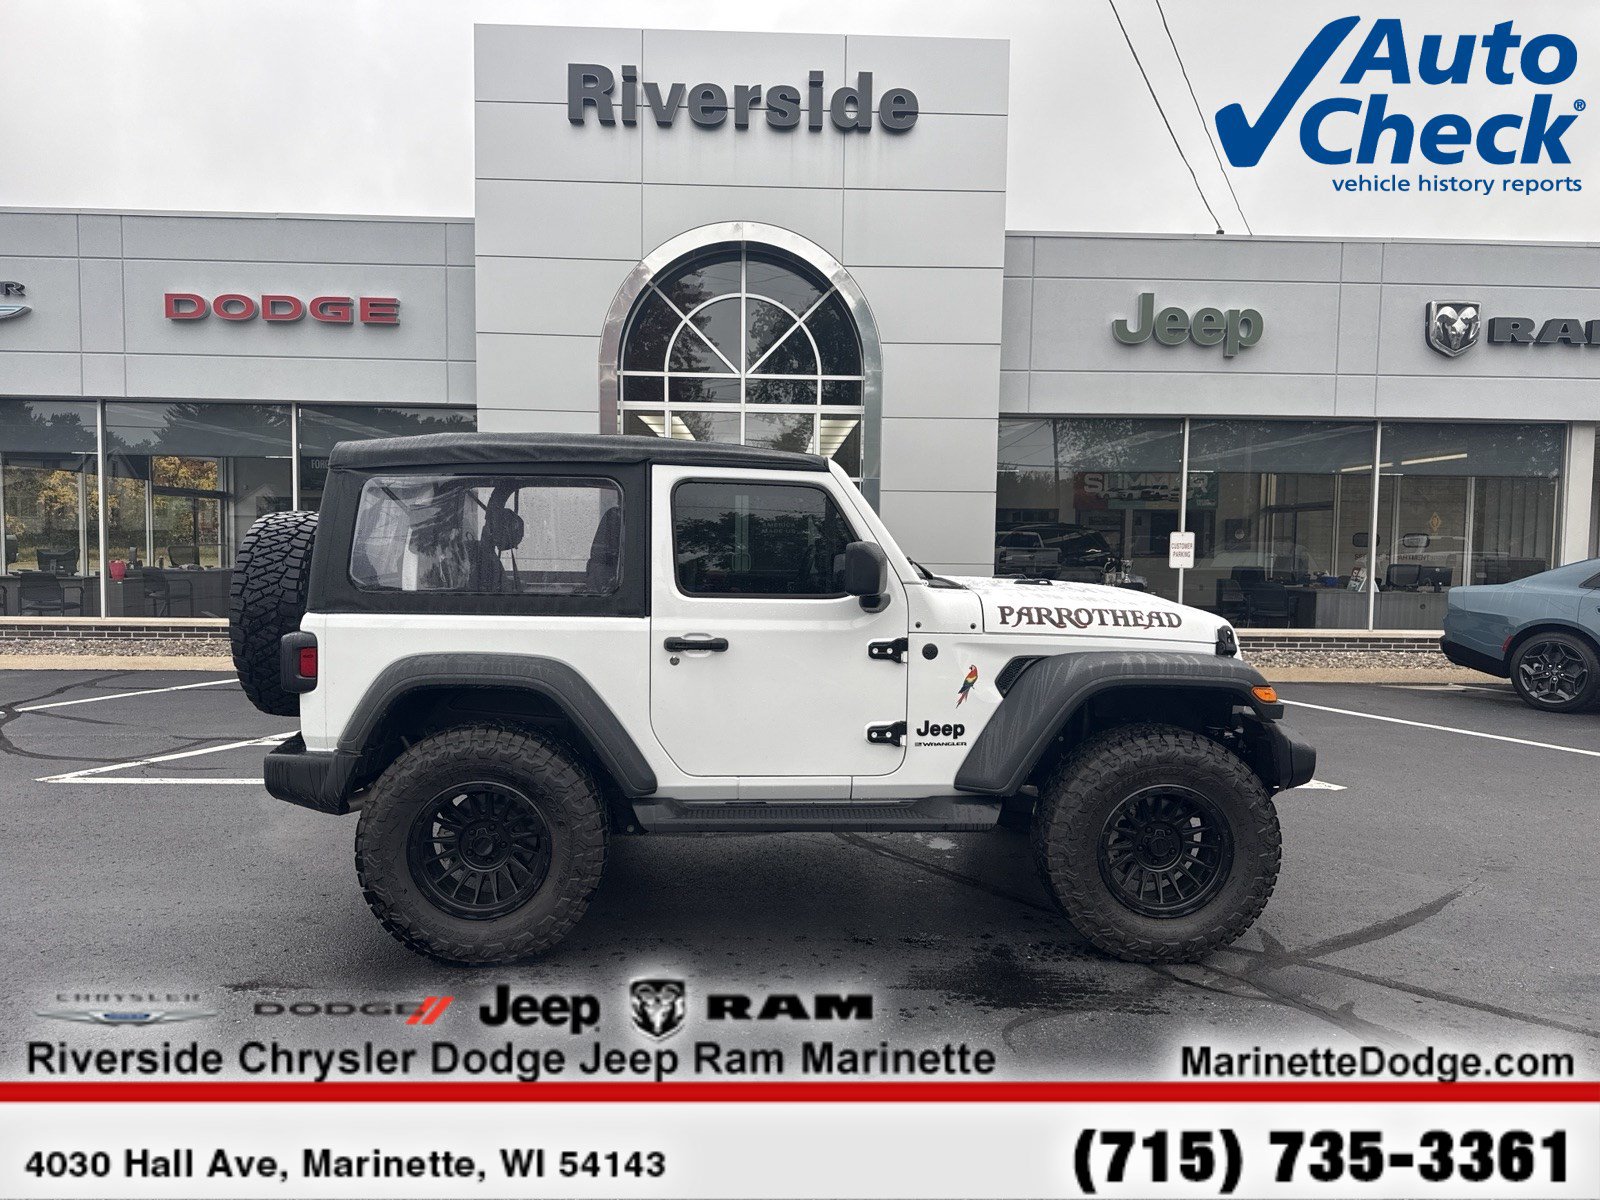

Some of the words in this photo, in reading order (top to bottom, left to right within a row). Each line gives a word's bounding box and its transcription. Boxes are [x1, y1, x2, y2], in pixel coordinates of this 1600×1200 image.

[567, 63, 919, 133] Riverside
[164, 292, 400, 325] DODGE
[1112, 293, 1264, 358] Jeep
[1171, 542, 1193, 550] CUSTOMER
[998, 605, 1182, 630] PARROTHEAD
[916, 720, 965, 739] Jeep
